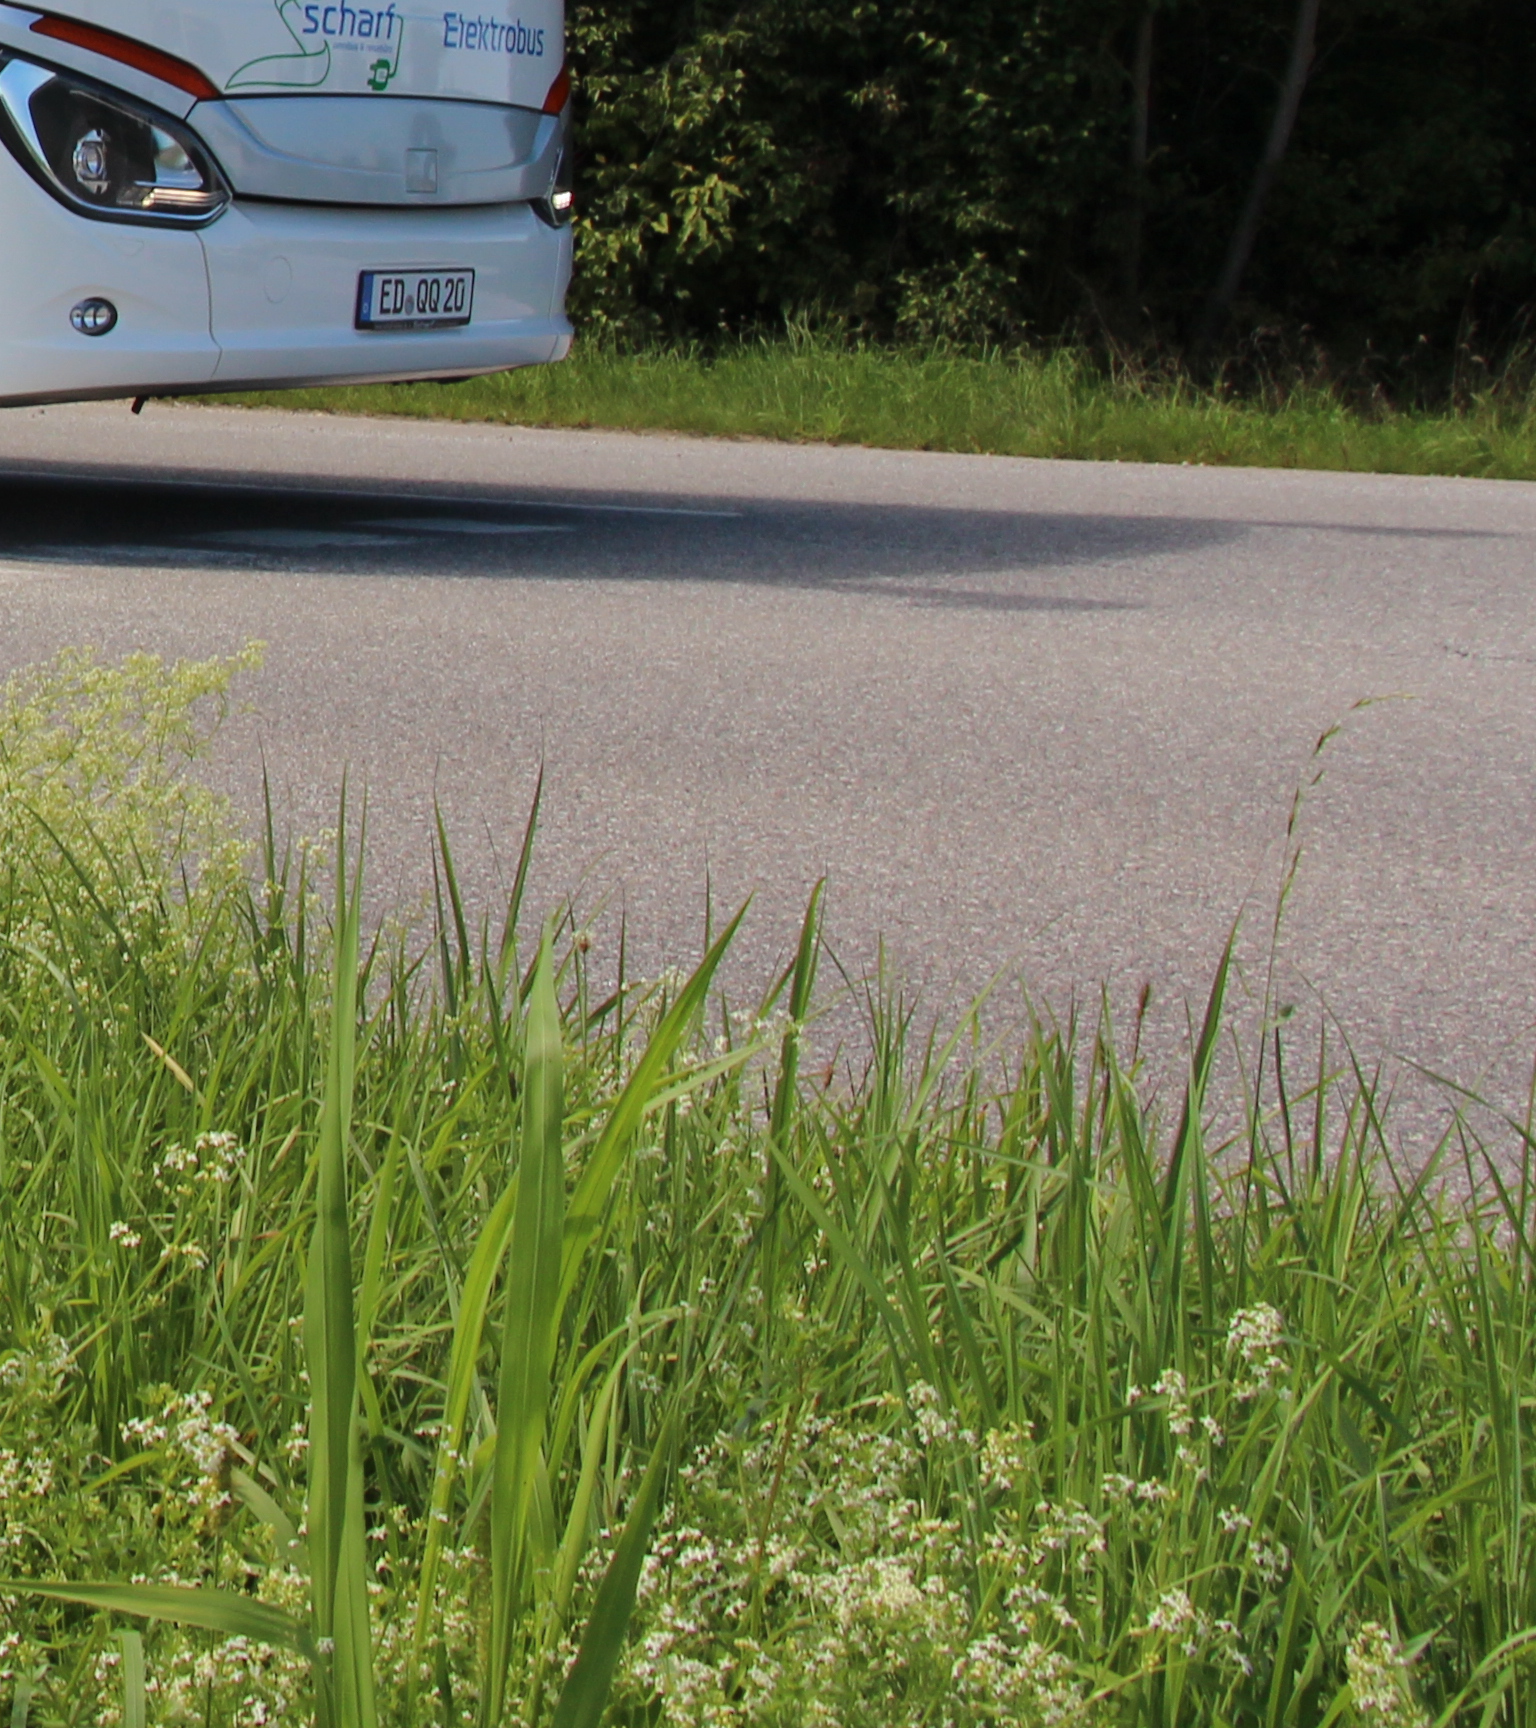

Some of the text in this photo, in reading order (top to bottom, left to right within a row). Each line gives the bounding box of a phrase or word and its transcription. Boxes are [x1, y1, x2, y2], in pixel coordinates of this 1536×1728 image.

[442, 11, 545, 57] Elektrobus
[379, 277, 465, 315] ED QQ 20
